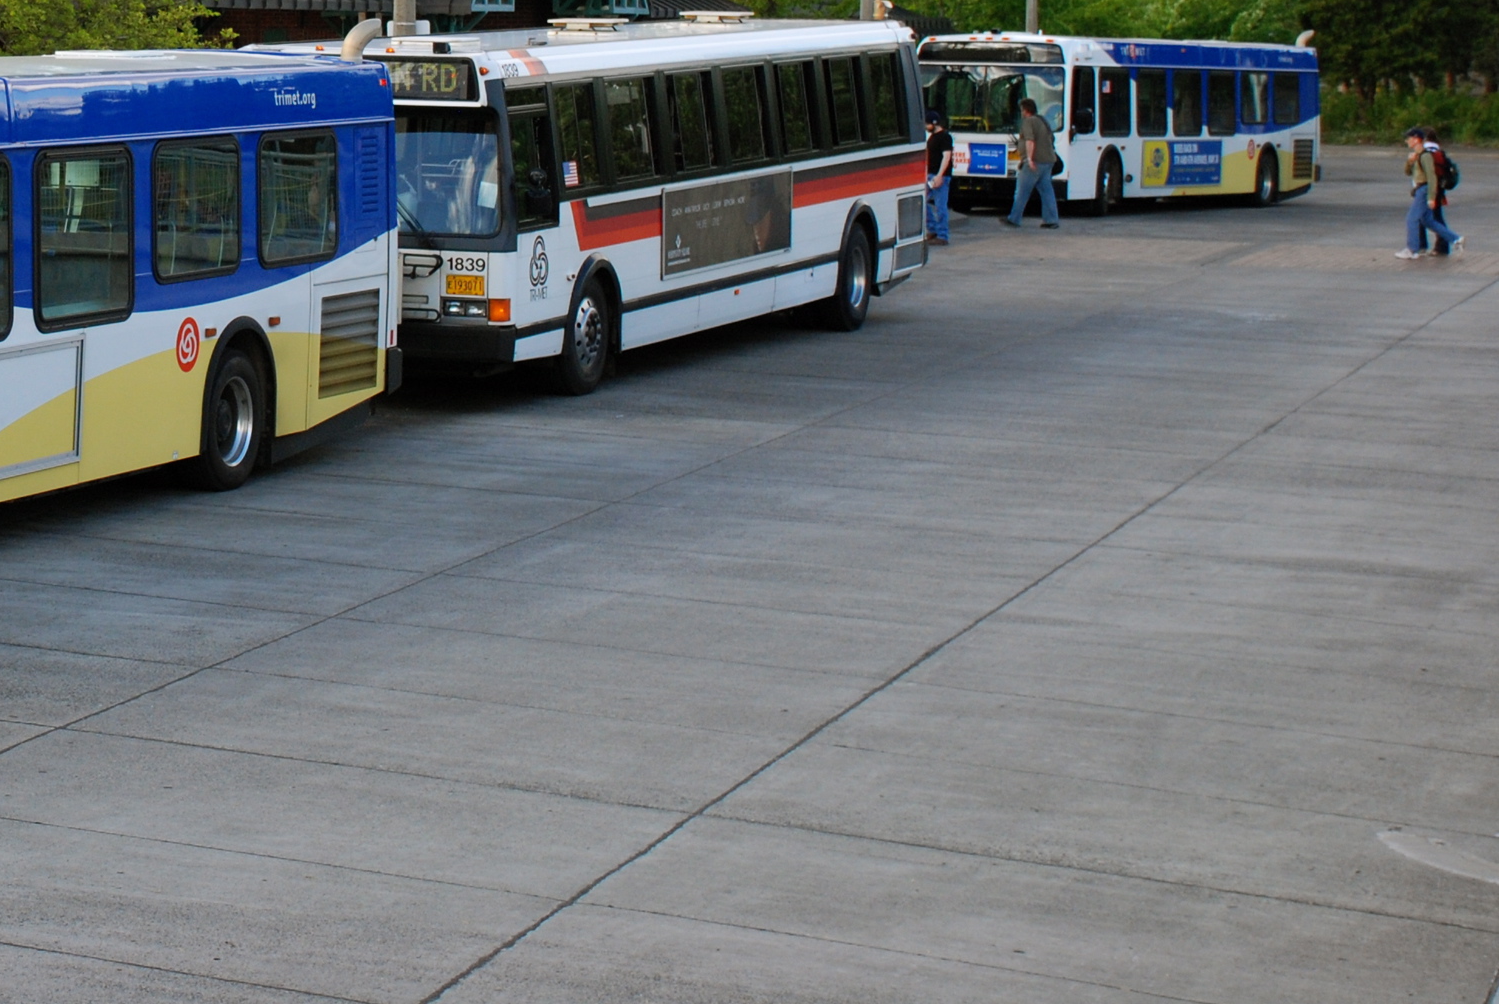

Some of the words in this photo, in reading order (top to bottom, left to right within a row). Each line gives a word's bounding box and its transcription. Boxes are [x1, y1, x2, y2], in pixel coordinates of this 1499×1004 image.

[421, 63, 457, 92] RD
[274, 90, 316, 109] trimet.org
[446, 257, 486, 272] 1839
